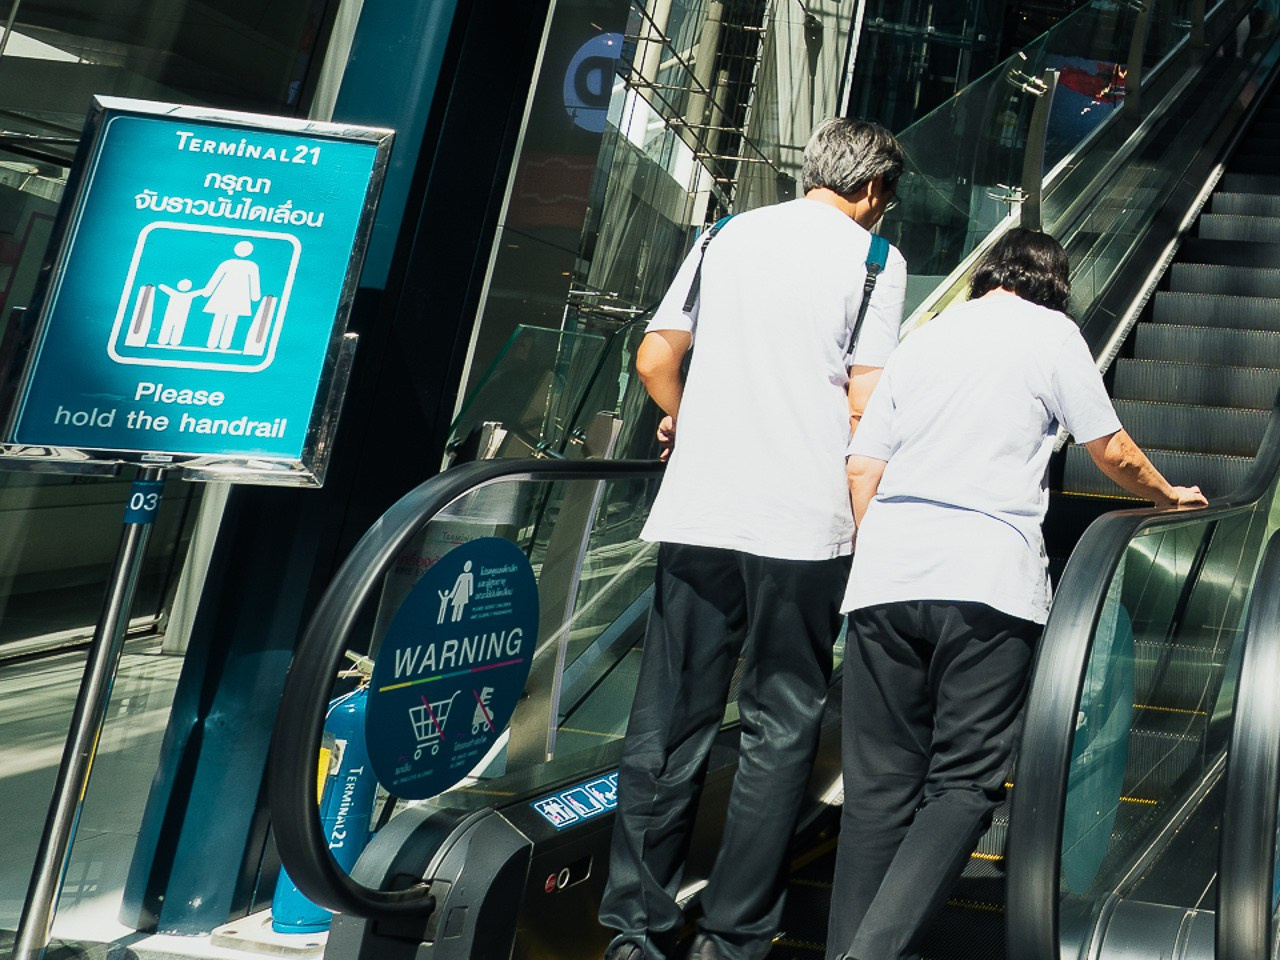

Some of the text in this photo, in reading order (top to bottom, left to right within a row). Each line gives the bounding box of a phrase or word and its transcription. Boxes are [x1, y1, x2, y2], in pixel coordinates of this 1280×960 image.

[203, 172, 271, 195] กรุณา
[134, 188, 324, 228] จับราวบันไดเลื่อน
[134, 382, 225, 407] Please
[53, 405, 288, 438] hold the handrail
[394, 627, 524, 679] WARNING
